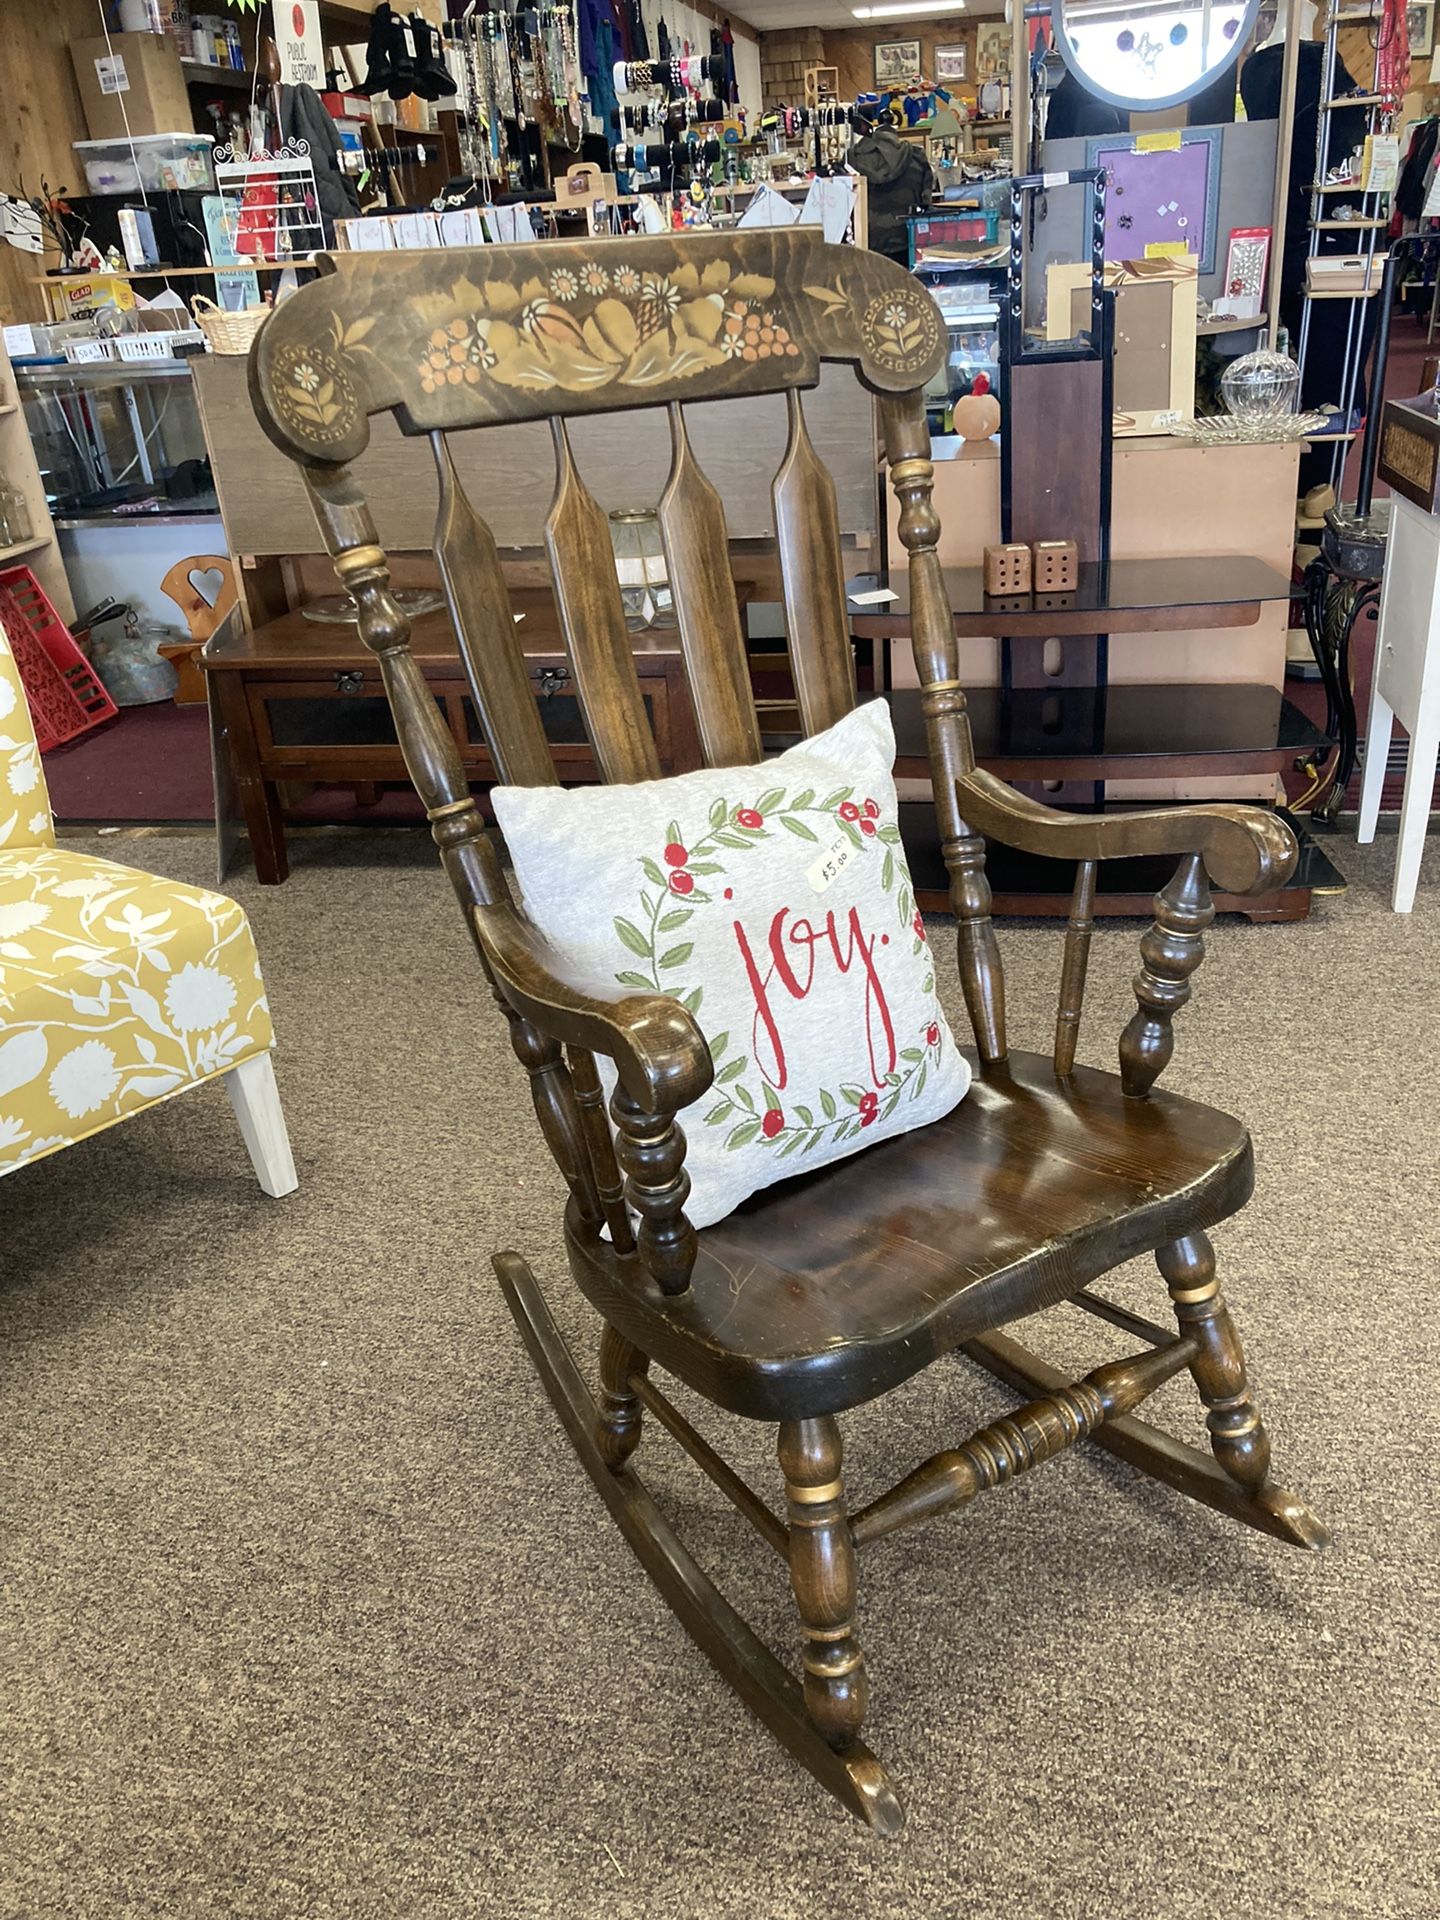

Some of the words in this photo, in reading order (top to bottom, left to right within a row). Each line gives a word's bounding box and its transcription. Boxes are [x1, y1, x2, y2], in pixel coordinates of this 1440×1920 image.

[286, 41, 307, 61] PUBLIC
[291, 63, 318, 81] RESTROOM
[71, 286, 91, 300] GLAD
[822, 852, 847, 882] $5.00
